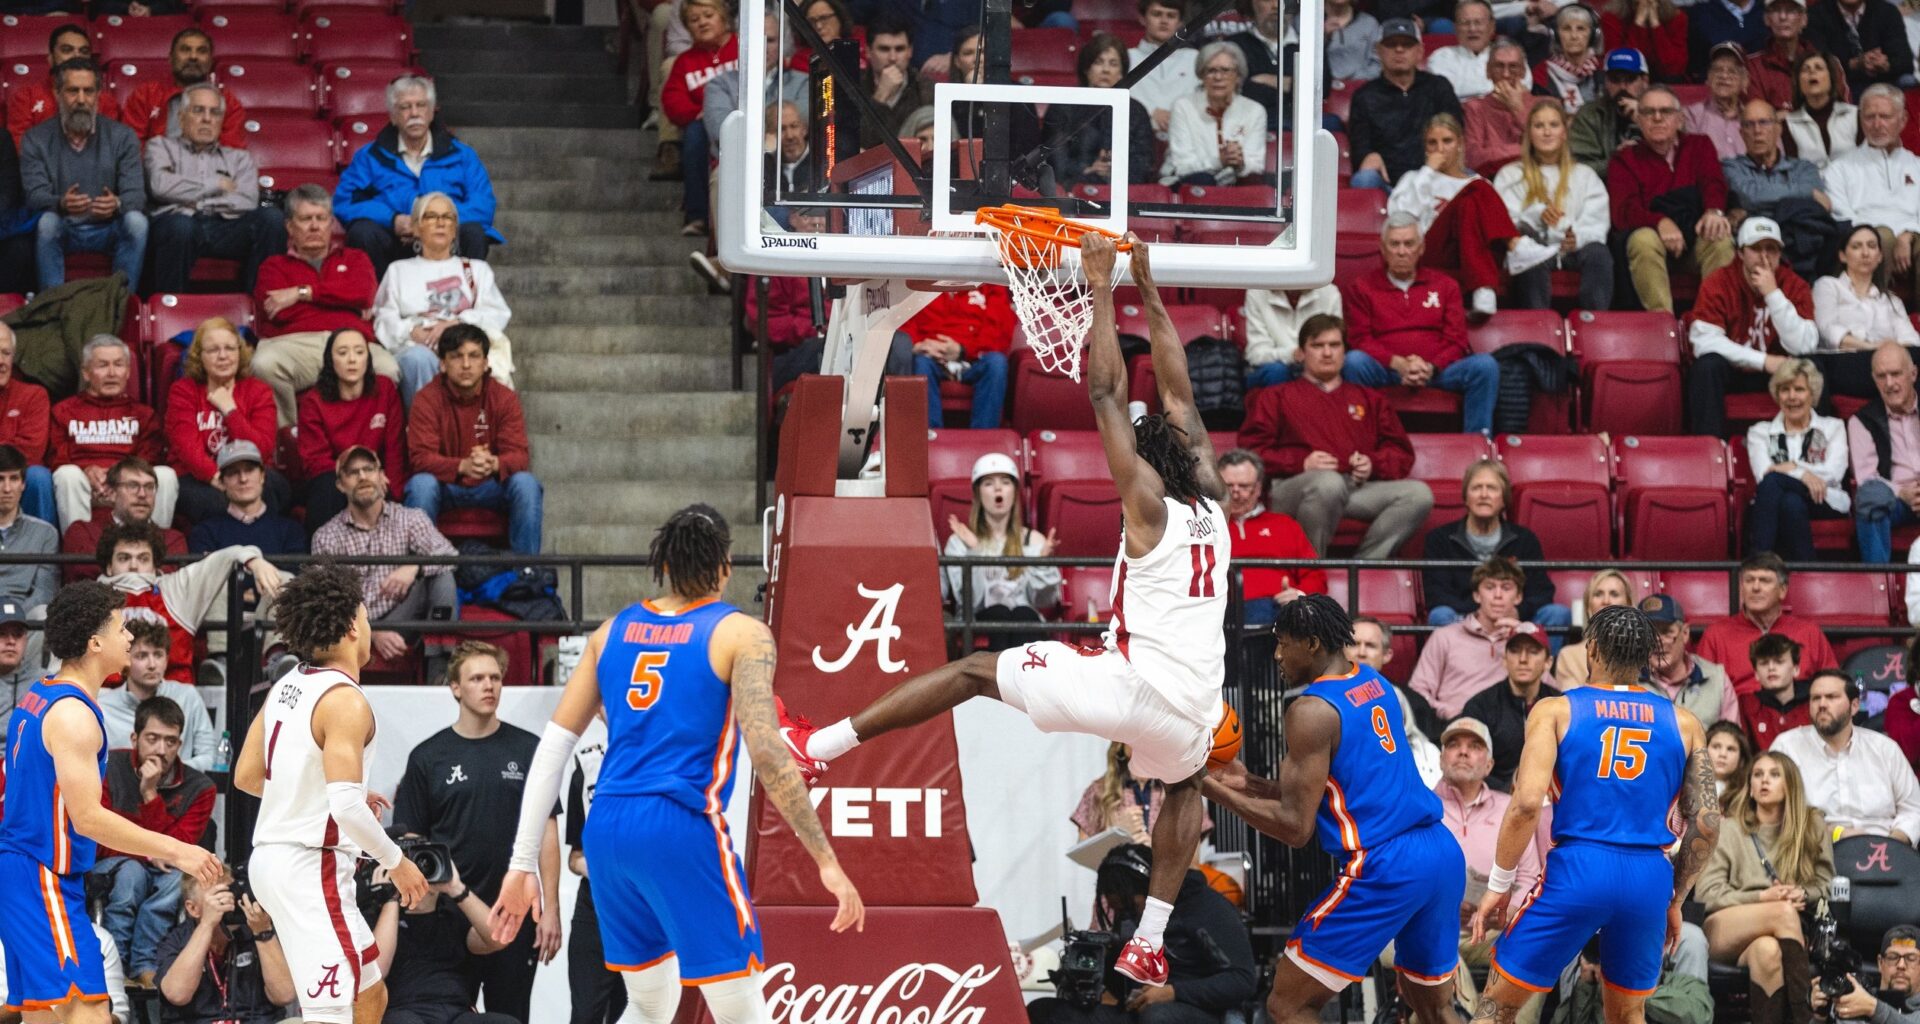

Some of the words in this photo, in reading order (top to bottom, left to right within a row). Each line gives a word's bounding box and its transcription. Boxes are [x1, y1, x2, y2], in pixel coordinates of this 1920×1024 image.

[761, 236, 817, 249] SPALDING
[69, 419, 140, 436] ALABAMA
[1189, 544, 1216, 597] 11
[624, 622, 695, 645] RICHARD
[812, 582, 905, 673] A
[626, 651, 670, 711] 5
[1873, 651, 1905, 680] A
[279, 684, 302, 710] SEARS
[1595, 699, 1655, 724] MARTIN
[1371, 705, 1397, 754] 9
[266, 720, 283, 781] 1
[1597, 726, 1652, 781] 15
[446, 764, 464, 785] A
[796, 787, 942, 838] ETI
[1855, 841, 1892, 872] A
[307, 963, 341, 998] A
